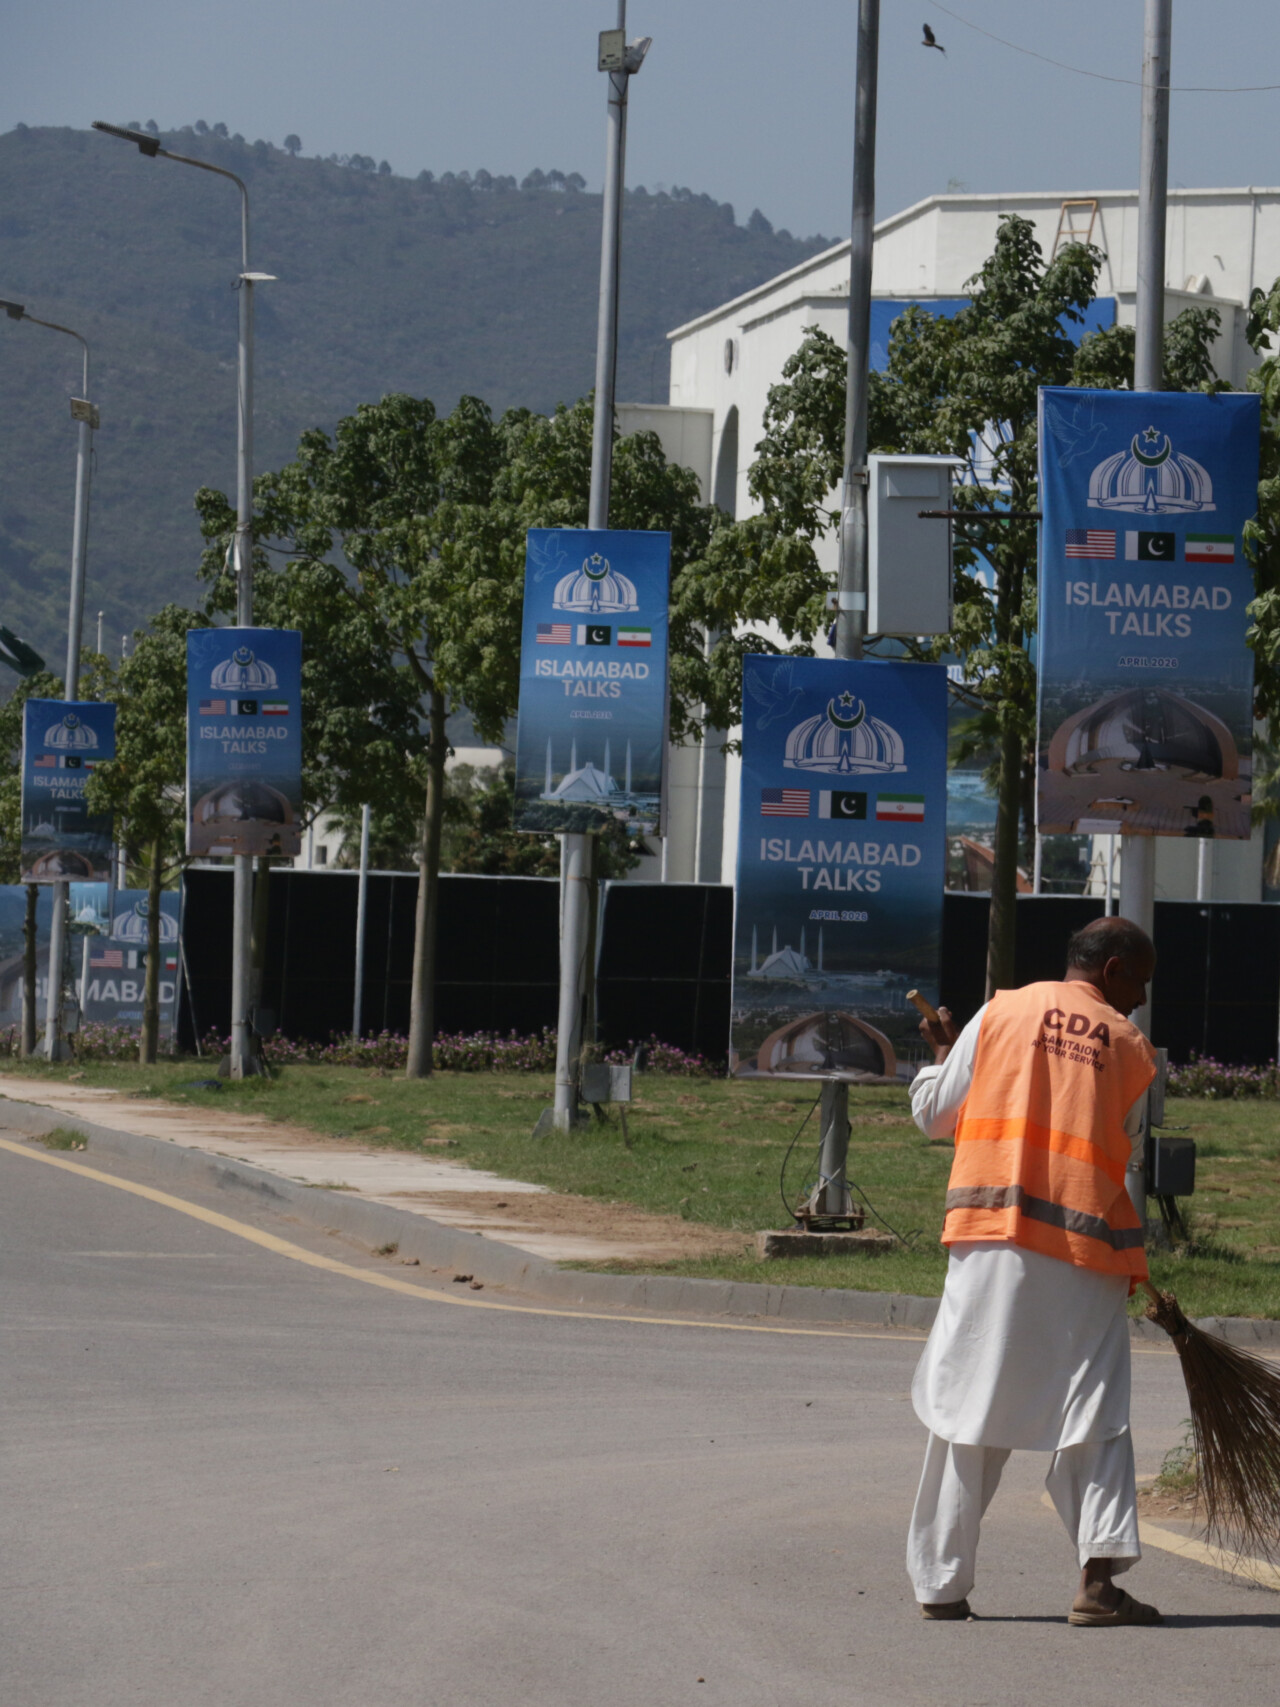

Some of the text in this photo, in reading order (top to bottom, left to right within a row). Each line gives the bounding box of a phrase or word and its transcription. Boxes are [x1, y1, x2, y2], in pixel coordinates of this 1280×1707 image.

[1065, 581, 1232, 610] ISLAMABAD
[1105, 611, 1192, 638] TALKS
[535, 659, 649, 679] ISLAMABAD
[1118, 656, 1178, 668] APRIL 2026
[562, 679, 621, 698] TALKS
[200, 726, 288, 740] ISLAMABAD
[221, 740, 267, 754] TALKS
[760, 838, 922, 867] ISLAMABAD
[797, 867, 882, 892] TALKS
[809, 909, 840, 921] APRIL
[1043, 1007, 1110, 1048] CDA
[1041, 1033, 1100, 1059] SANITAION
[1043, 1044, 1066, 1058] YOUR
[1069, 1051, 1105, 1072] SERVICE
